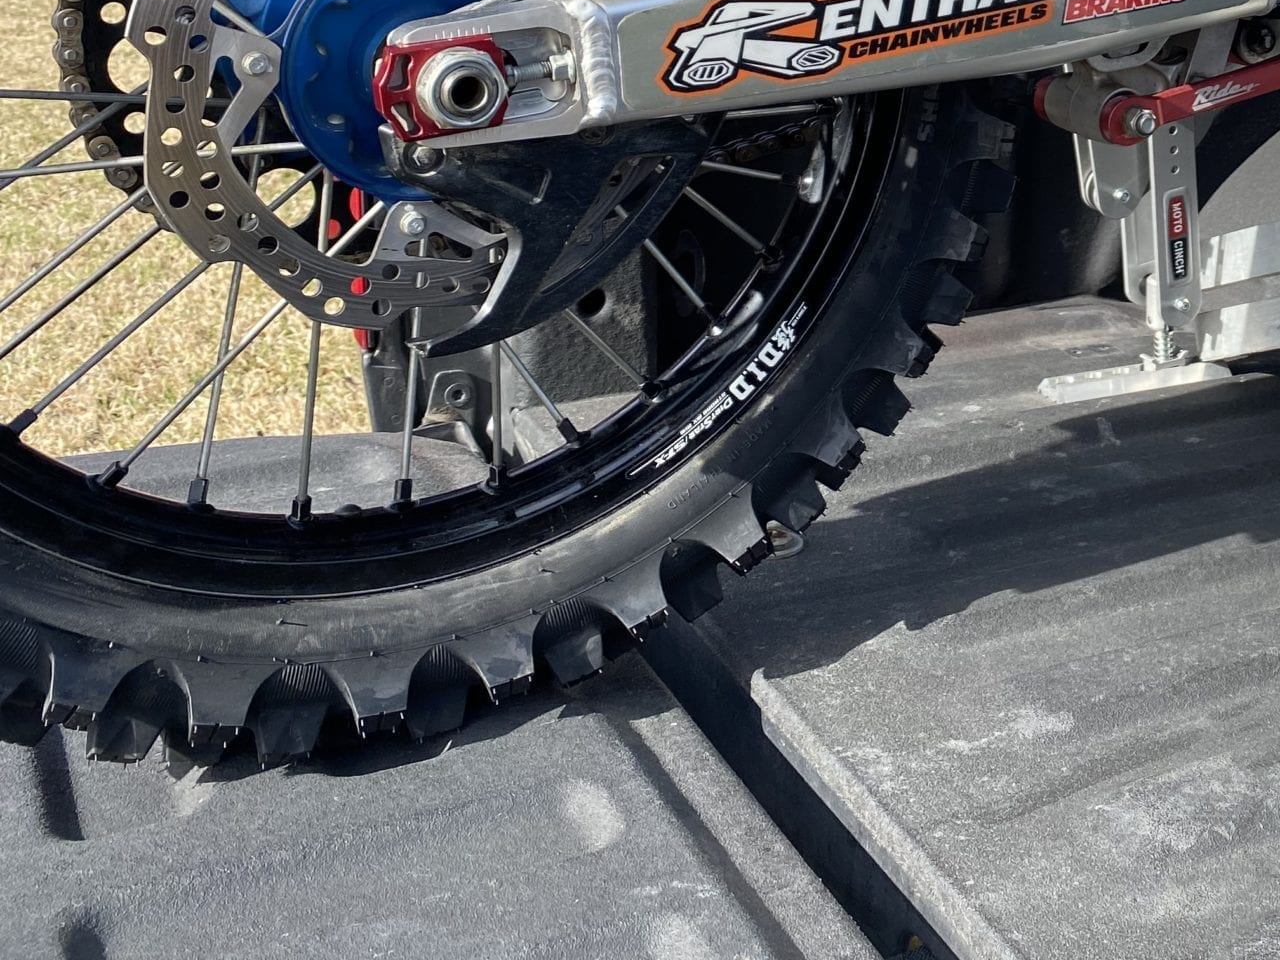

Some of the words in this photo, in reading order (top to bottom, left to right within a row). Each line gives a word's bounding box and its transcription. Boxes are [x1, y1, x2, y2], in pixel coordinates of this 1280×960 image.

[848, 2, 1048, 60] CHAINWHEELS
[1169, 200, 1185, 236] MOTO
[1172, 241, 1186, 277] CINCH
[728, 341, 785, 401] D.I.D
